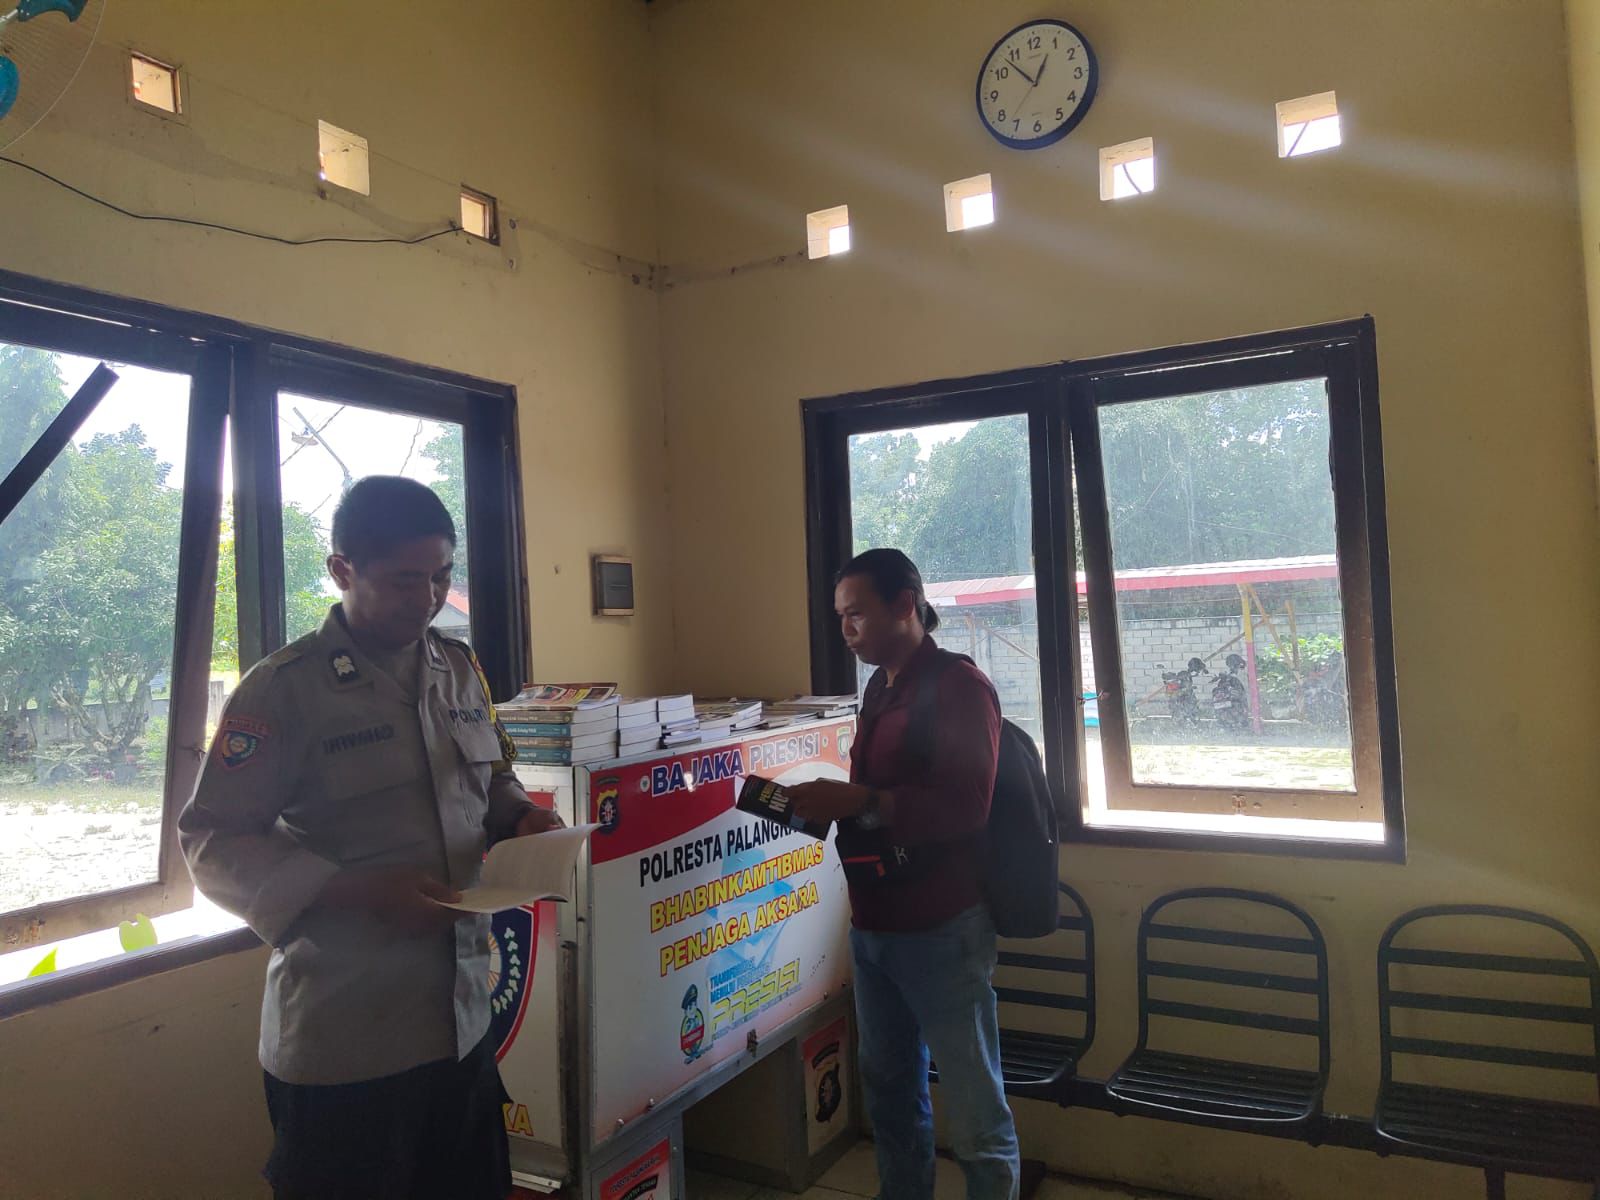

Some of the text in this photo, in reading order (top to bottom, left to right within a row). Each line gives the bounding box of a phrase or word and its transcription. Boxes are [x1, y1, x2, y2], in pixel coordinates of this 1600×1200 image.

[1027, 36, 1041, 51] 12
[1052, 37, 1058, 49] 1
[1009, 47, 1020, 62] 11
[1066, 47, 1076, 61] 2
[995, 66, 1009, 81] 10
[1073, 66, 1083, 80] 3
[990, 90, 999, 102] 9
[1067, 90, 1077, 103] 4
[998, 109, 1006, 122] 8
[1055, 107, 1064, 121] 5
[1013, 119, 1021, 132] 7
[1033, 120, 1042, 132] 6
[651, 748, 745, 797] BAJAKA
[750, 732, 821, 772] PRESISI
[639, 820, 798, 888] POLRESTA PALANG
[651, 840, 824, 933] BHABINKAMTIBMAS
[660, 912, 751, 977] PENJAGA
[754, 882, 820, 932] AKSARA
